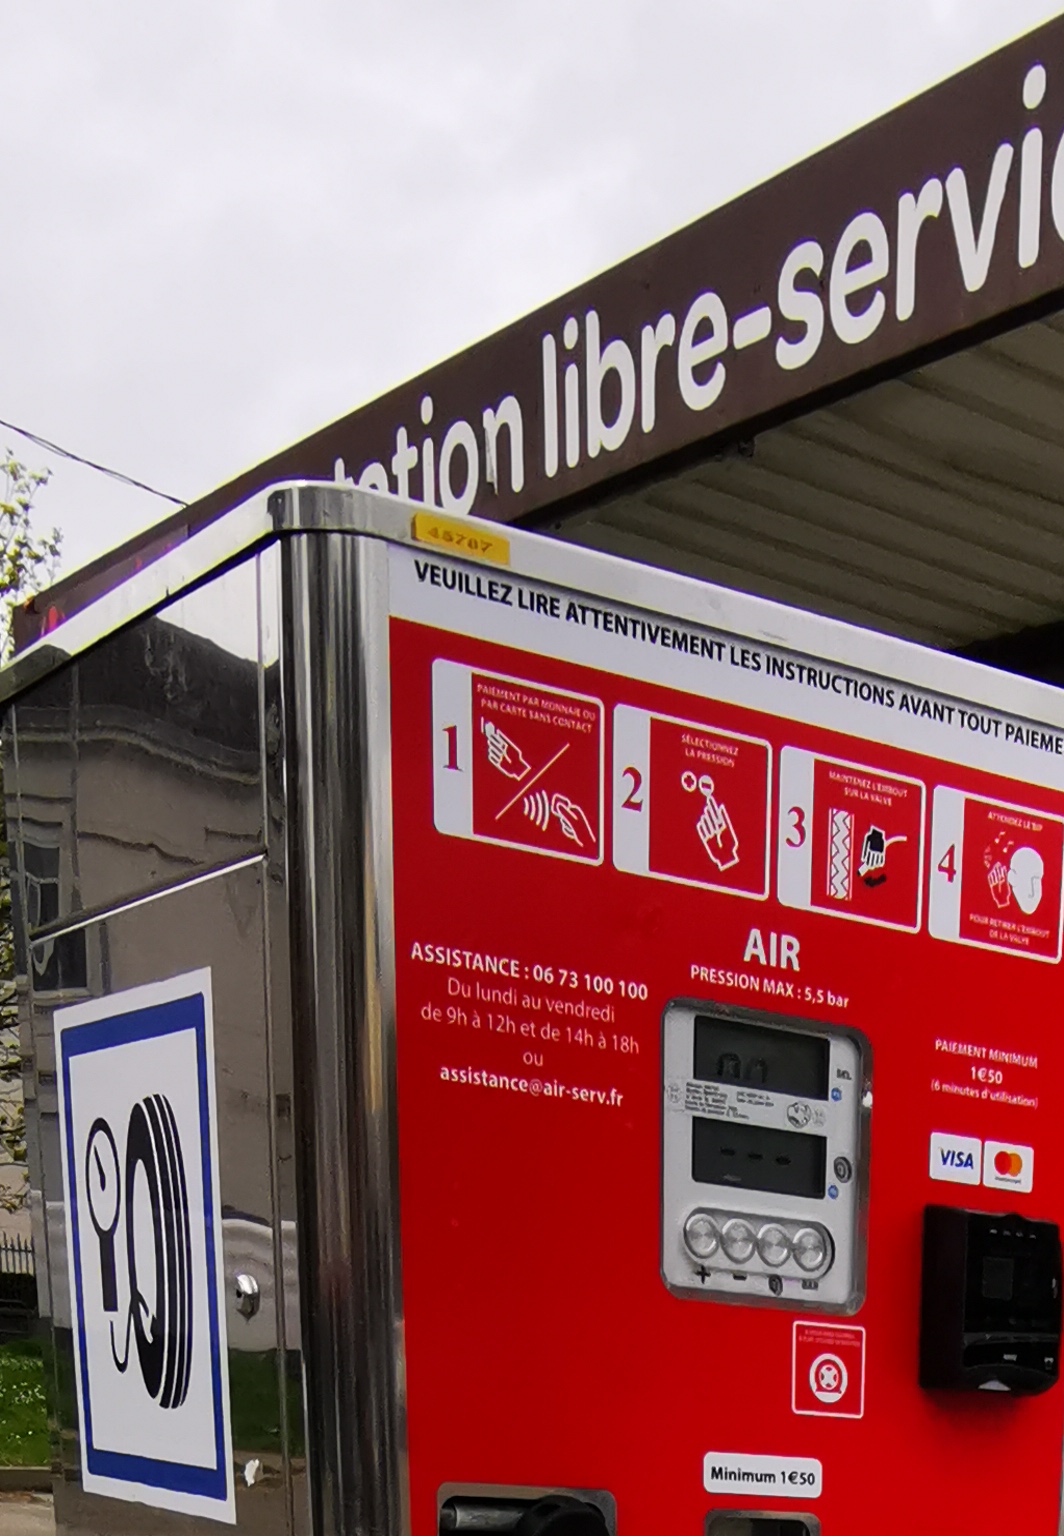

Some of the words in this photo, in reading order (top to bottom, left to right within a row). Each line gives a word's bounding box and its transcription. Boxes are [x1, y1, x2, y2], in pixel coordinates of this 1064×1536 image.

[335, 396, 524, 516] tion
[414, 559, 513, 606] VEUILLEZ
[518, 588, 561, 619] LIRE
[565, 601, 726, 662] ATTENTIVEMENT
[730, 646, 762, 672] LES
[766, 656, 895, 708] INSTRUCTIONS
[899, 694, 956, 727] AVANT
[958, 710, 1004, 738] TOUT
[477, 683, 521, 701] PAIEMENT
[523, 693, 539, 706] PAR
[541, 699, 581, 718] MONNAIE
[582, 710, 596, 722] OU
[480, 698, 499, 709] PAR
[500, 702, 527, 718] CARTE
[529, 709, 551, 724] SANS
[552, 715, 592, 734] CONTACT
[442, 724, 463, 772] 1
[685, 748, 696, 758] LA
[697, 750, 735, 768] PRESSION
[621, 765, 643, 813] 2
[828, 770, 871, 790] MAINTENEZ
[844, 787, 859, 798] SUR
[859, 790, 870, 801] LA
[870, 793, 893, 807] VALVE
[785, 806, 806, 848] 3
[938, 843, 957, 884] 4
[969, 913, 989, 926] POUR
[999, 932, 1009, 941] LA
[1009, 933, 1030, 946] VALVE
[743, 928, 801, 972] AIR
[411, 941, 520, 978] ASSISTANCE
[533, 964, 554, 984] 06
[558, 969, 579, 988] 73
[584, 973, 613, 995] 100
[619, 979, 648, 1000] 100
[690, 964, 760, 991] PRESSION
[763, 978, 794, 999] MAX
[804, 987, 824, 1005] 5,5
[827, 990, 849, 1009] bar
[448, 977, 471, 999] Du
[476, 981, 518, 1007] lundi
[522, 994, 541, 1010] au
[545, 997, 615, 1023] vendredi
[421, 1002, 442, 1022] de
[446, 1006, 467, 1026] 9h
[472, 1010, 481, 1029] à
[487, 1013, 516, 1035] 12h
[520, 1021, 536, 1038] et
[540, 1023, 560, 1042] de
[566, 1027, 593, 1048] 14h
[598, 1031, 607, 1050] à
[612, 1035, 639, 1054] 18h
[523, 1051, 544, 1067] ou
[935, 1039, 986, 1059] PAIEMENT
[988, 1048, 1038, 1069] MINIMUM
[440, 1066, 623, 1107] assistance@air-serv.fr
[930, 1078, 940, 1092] (6
[941, 1083, 979, 1099] minutes
[981, 1088, 1039, 1110] d'utilisation)
[970, 1065, 1003, 1084] 1€50
[940, 1147, 974, 1170] VISA
[710, 1466, 776, 1484] Minimum
[780, 1471, 815, 1486] 1€50
